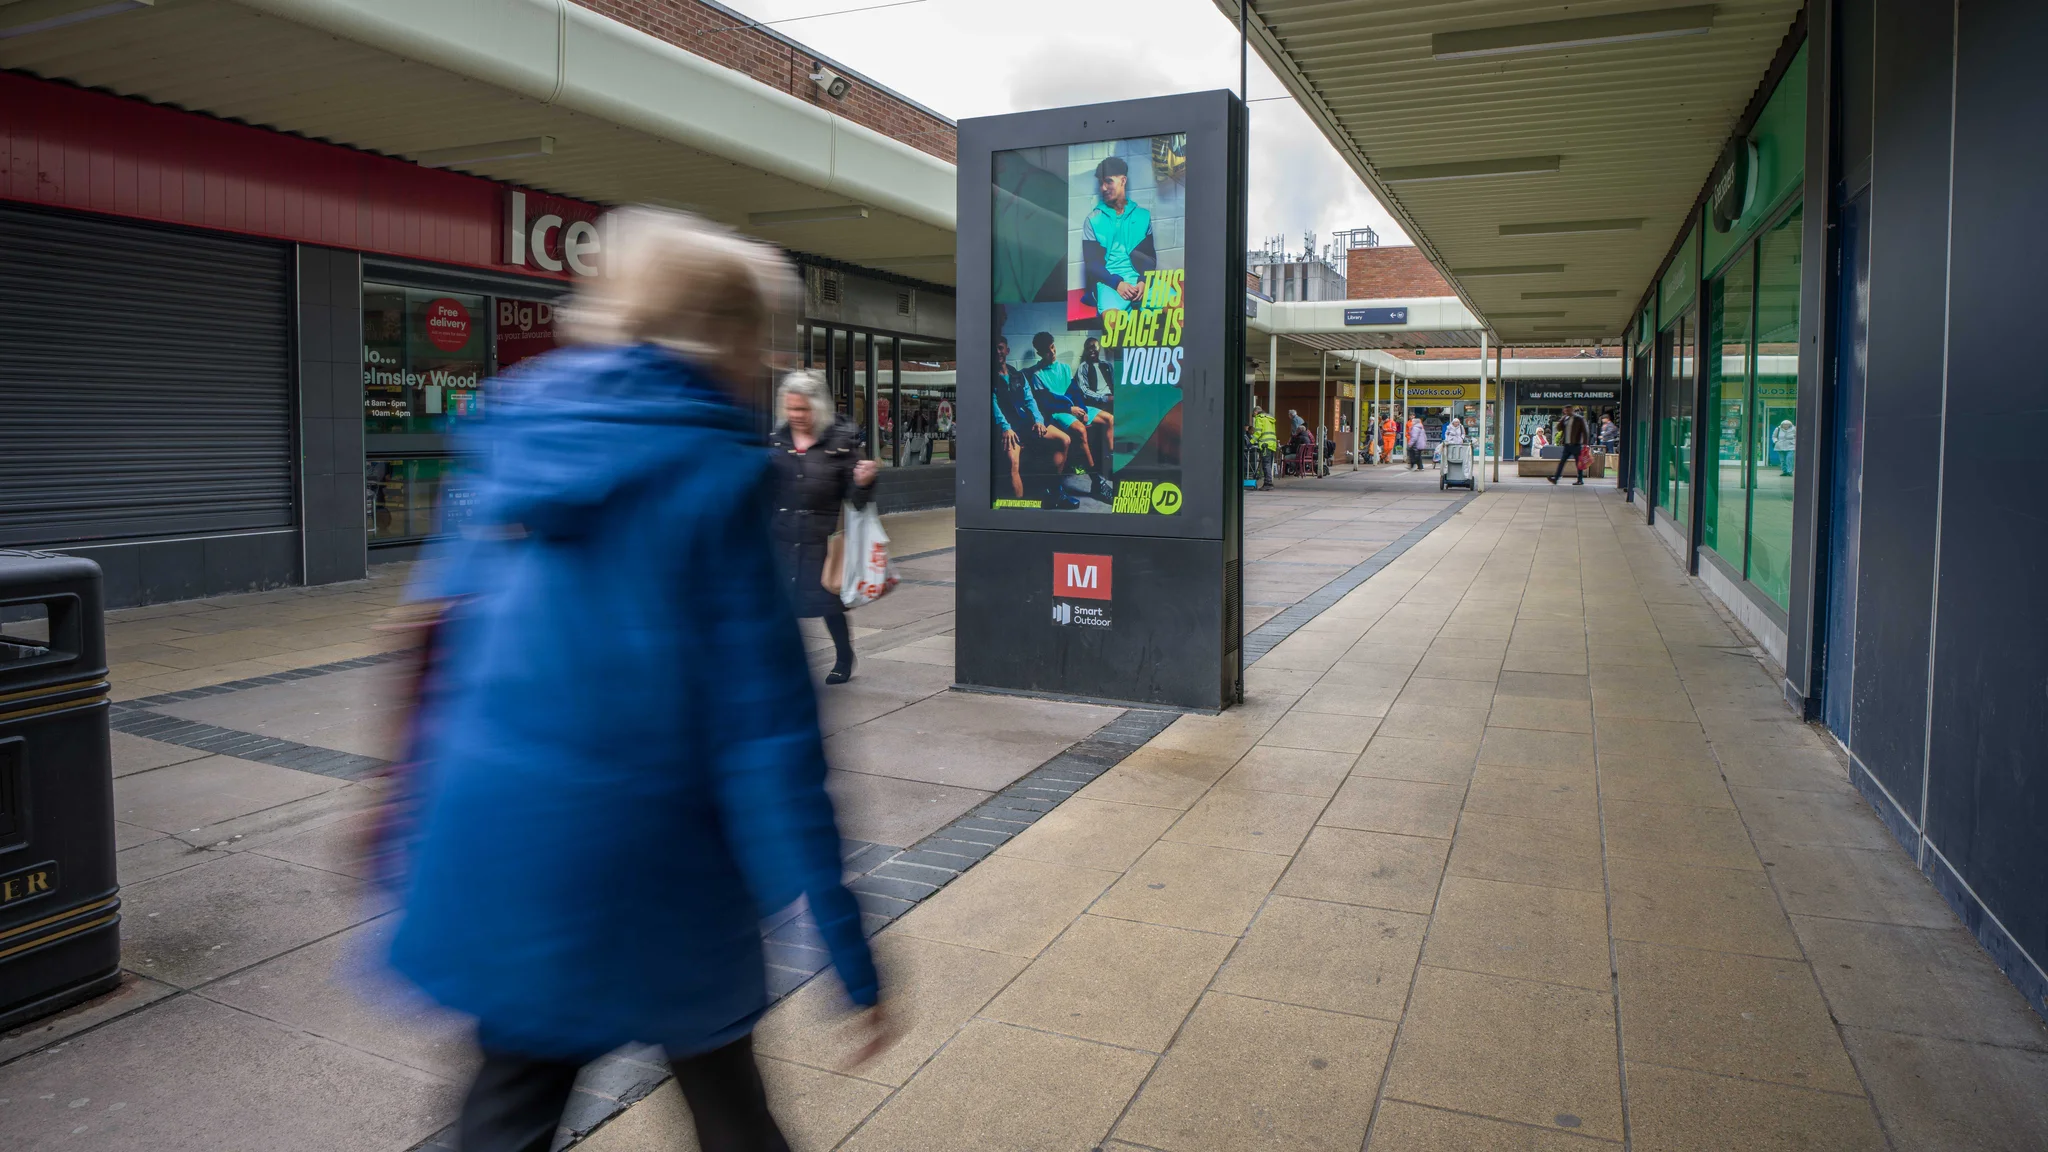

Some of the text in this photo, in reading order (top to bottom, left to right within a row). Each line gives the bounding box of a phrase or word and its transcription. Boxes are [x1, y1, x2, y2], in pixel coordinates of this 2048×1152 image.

[1141, 268, 1185, 307] THIS
[438, 306, 458, 317] Free
[500, 301, 533, 332] Big
[430, 316, 466, 330] delivery
[1100, 308, 1185, 348] SPACE IS
[505, 333, 520, 341] your
[522, 330, 552, 340] favourite
[364, 345, 396, 364] lo...
[1121, 346, 1184, 386] YOURS
[364, 367, 477, 390] elmsley Wood
[391, 400, 406, 409] 6pm
[395, 410, 411, 418] 4pm
[1519, 414, 1551, 425] THIS SPACE
[1118, 481, 1153, 498] FOREVER
[1112, 496, 1151, 514] FORWARD
[1156, 491, 1178, 506] JD
[1067, 564, 1098, 588] M
[1074, 606, 1103, 617] Smart
[1074, 616, 1111, 627] Outdoor
[3, 872, 49, 902] ER
